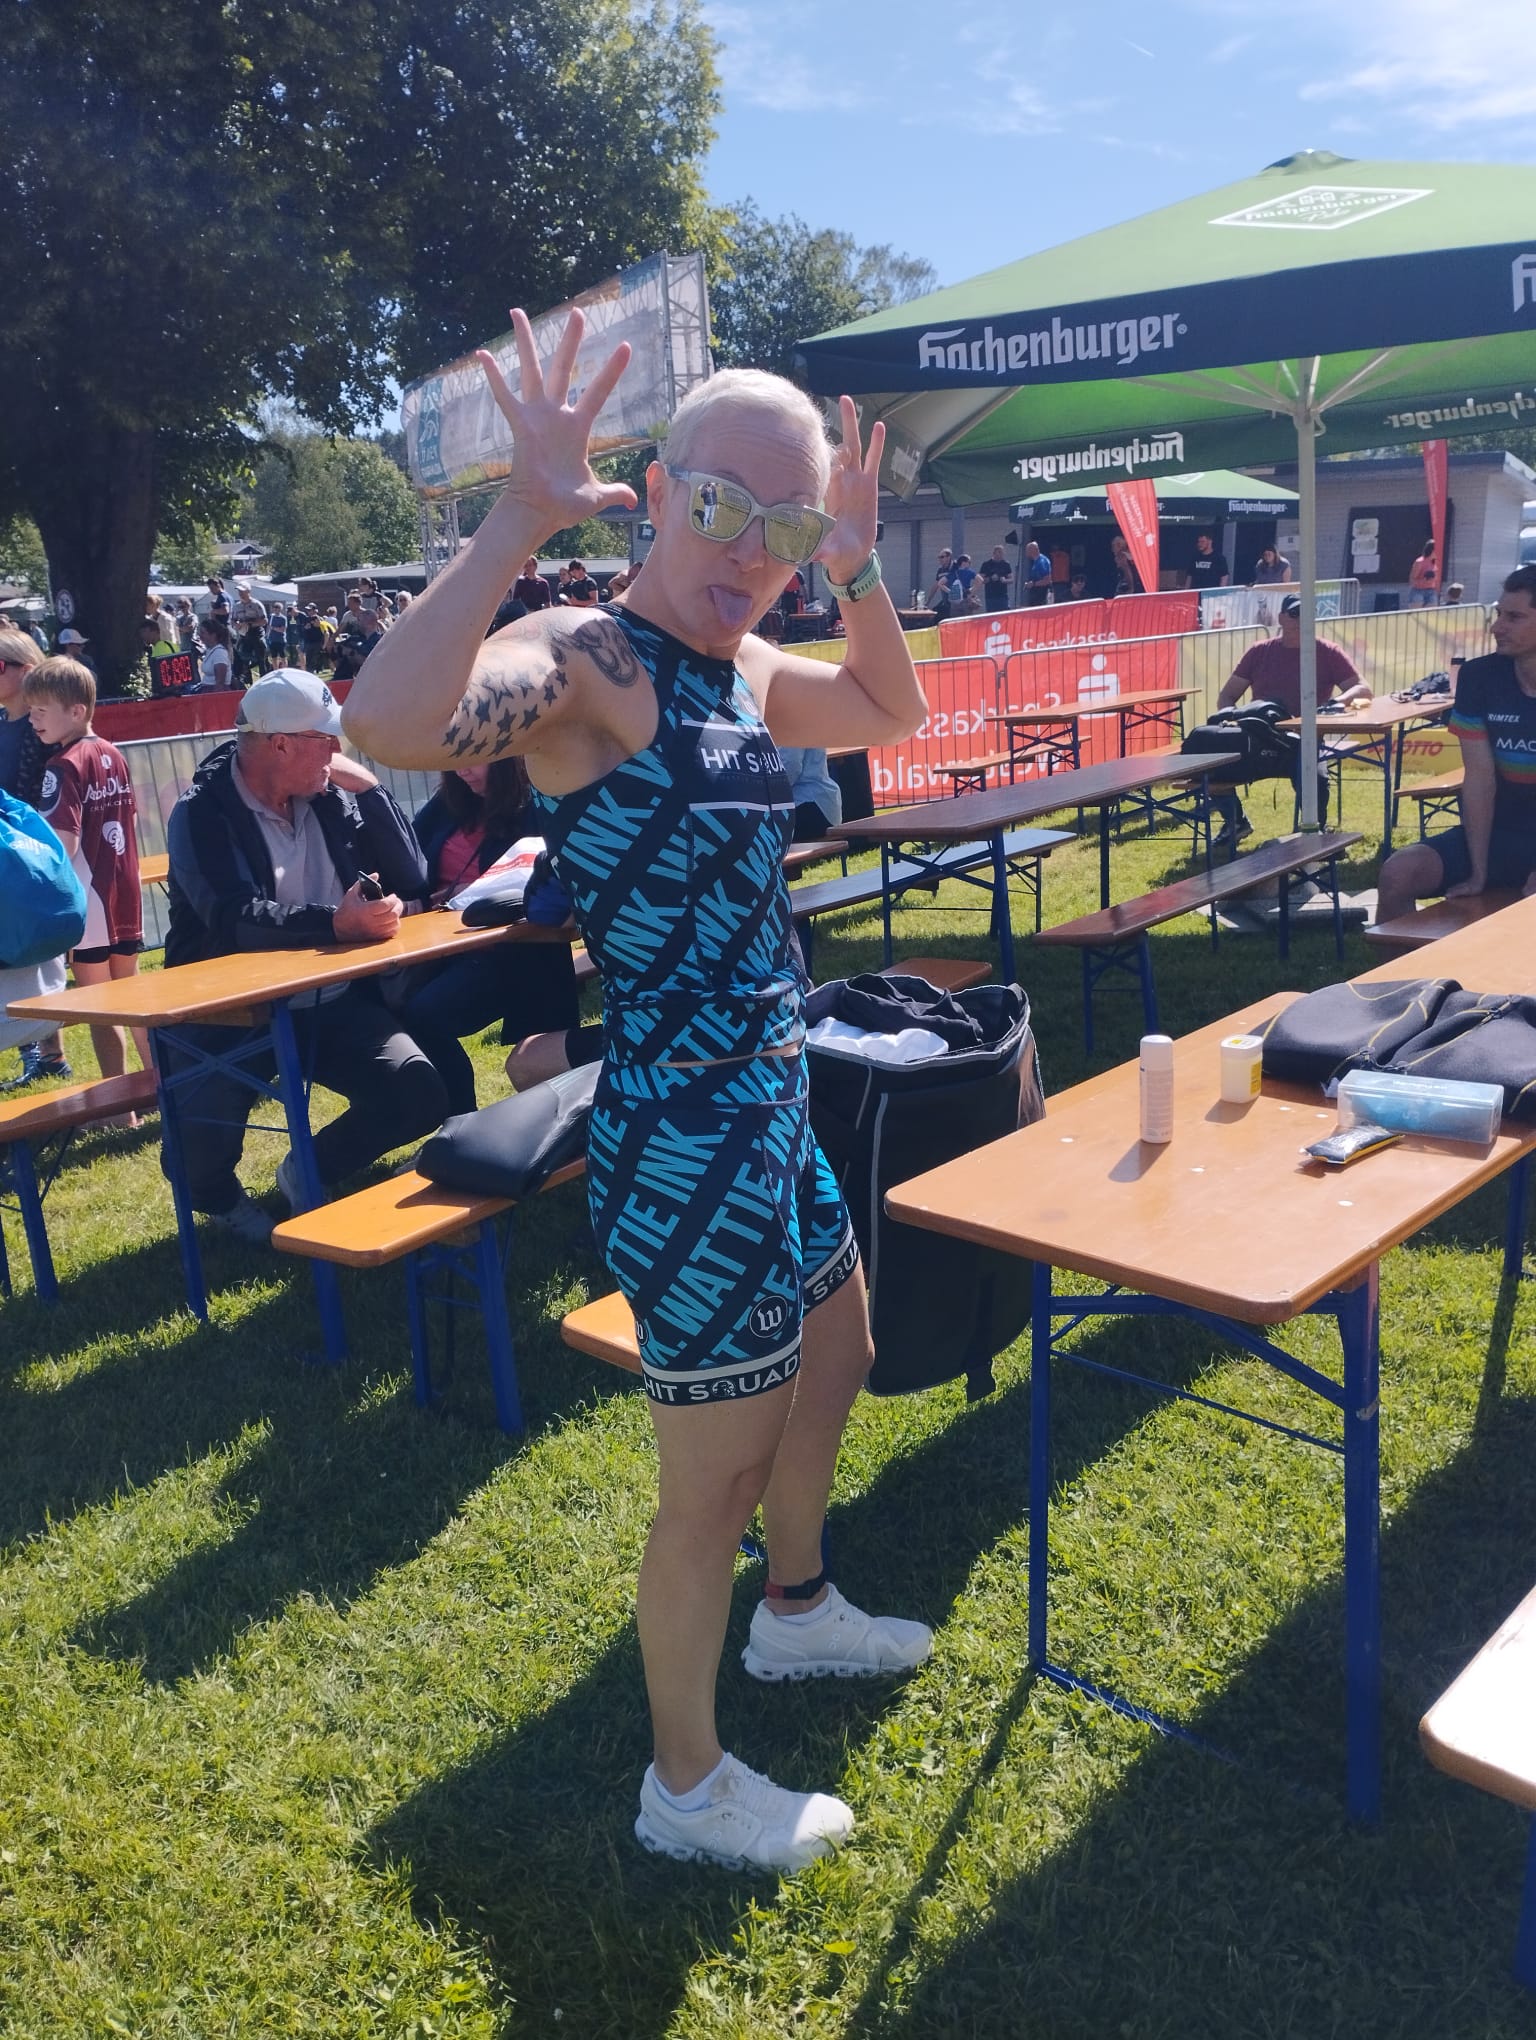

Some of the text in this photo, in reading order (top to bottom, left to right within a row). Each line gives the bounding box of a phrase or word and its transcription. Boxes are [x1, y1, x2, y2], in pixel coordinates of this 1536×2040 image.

[701, 748, 741, 770] HIT
[653, 1162, 783, 1337] WATTIE
[643, 1373, 677, 1402] HIT
